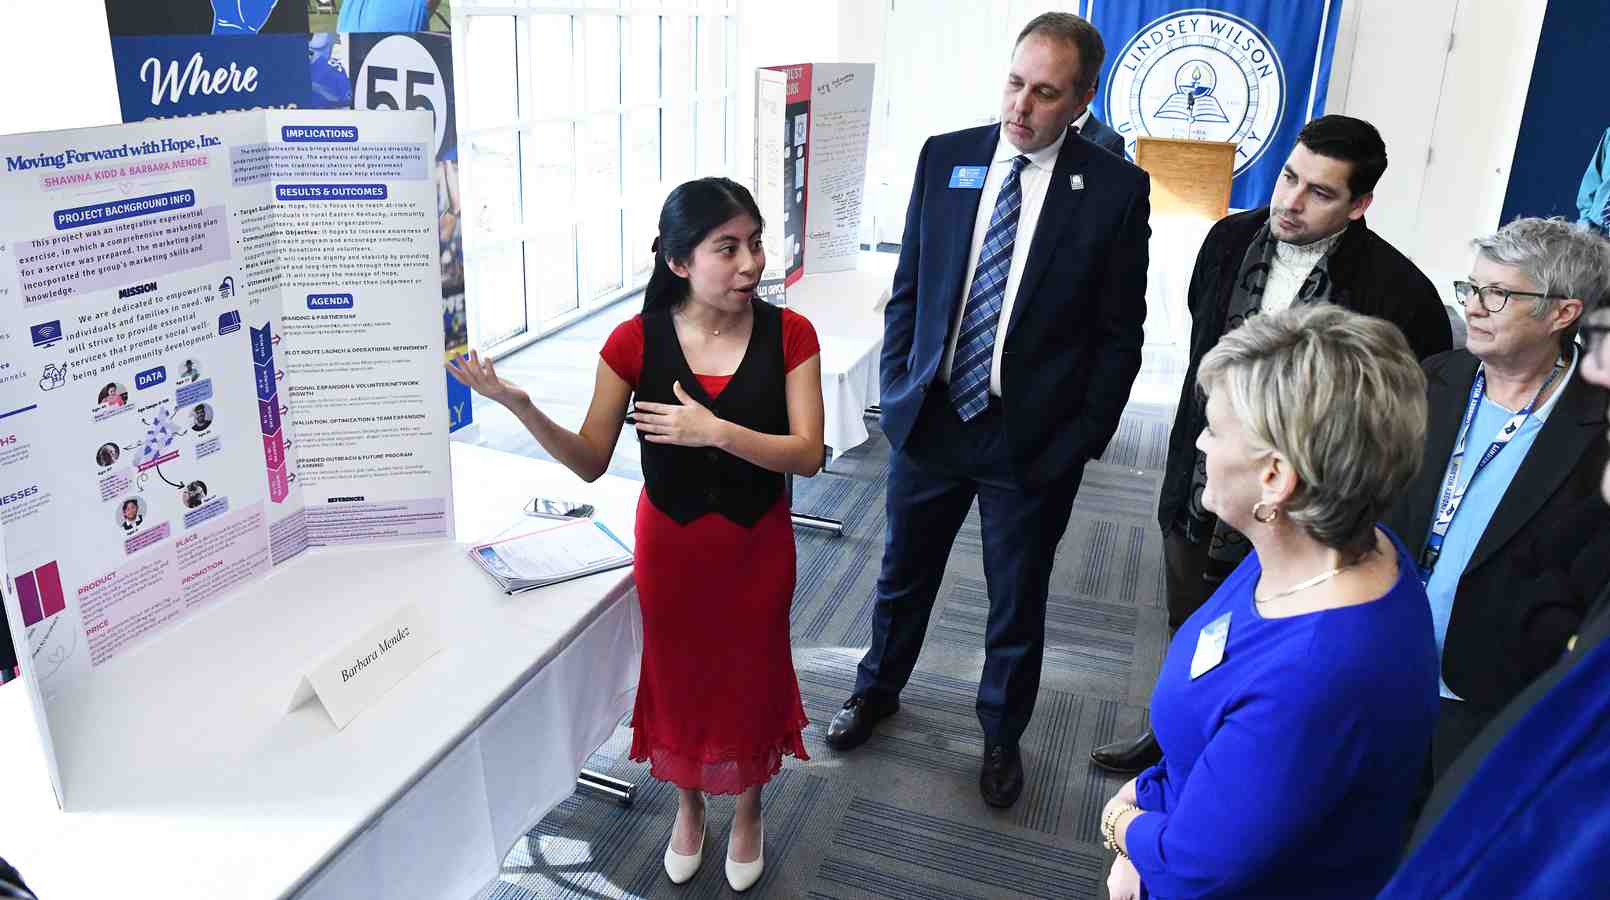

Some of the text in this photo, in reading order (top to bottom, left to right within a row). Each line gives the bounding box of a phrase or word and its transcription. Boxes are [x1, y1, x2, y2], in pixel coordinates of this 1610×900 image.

[1124, 19, 1273, 79] LINDSEY WILSON
[140, 52, 258, 105] Where
[286, 129, 354, 138] IMPLICATIONS
[6, 134, 221, 172] Moving Forward with Hope, Inc.
[44, 157, 208, 187] SHAWNA KIDD & BARBARA MENDEZ
[58, 193, 191, 224] PROJECT BACKGROUND INFO
[280, 187, 384, 196] RESULTS & OUTCOMES
[19, 252, 60, 265] exercise,
[62, 248, 70, 256] in
[72, 242, 98, 254] which
[107, 230, 164, 246] comprehensive
[166, 221, 202, 234] marketing
[203, 218, 218, 228] plan
[32, 209, 203, 249] This project was an integrative experiential
[21, 269, 35, 278] for
[46, 260, 75, 273] service
[78, 257, 94, 265] was
[97, 247, 135, 262] prepared.
[137, 244, 150, 253] The
[152, 235, 189, 249] marketing
[191, 232, 206, 242] plan
[24, 243, 203, 291] incorporated the group's marketing skills and
[26, 286, 76, 303] knowledge.
[78, 283, 212, 324] We are dedicated to empowering
[118, 281, 158, 300] MISSION
[311, 296, 350, 305] AGENDA
[66, 295, 215, 341] individuals and families in need. We
[68, 311, 197, 354] will strive to provide essential
[70, 320, 210, 368] services that promote social well-
[73, 332, 217, 382] being and community development.
[140, 370, 163, 386] DATA
[0, 485, 38, 506] ESSES
[176, 533, 198, 549] PLACE
[78, 571, 118, 595] PRODUCT
[182, 559, 224, 584] PROMOTION
[86, 619, 109, 636] PRICE
[341, 627, 410, 683] Barbara Mendez
